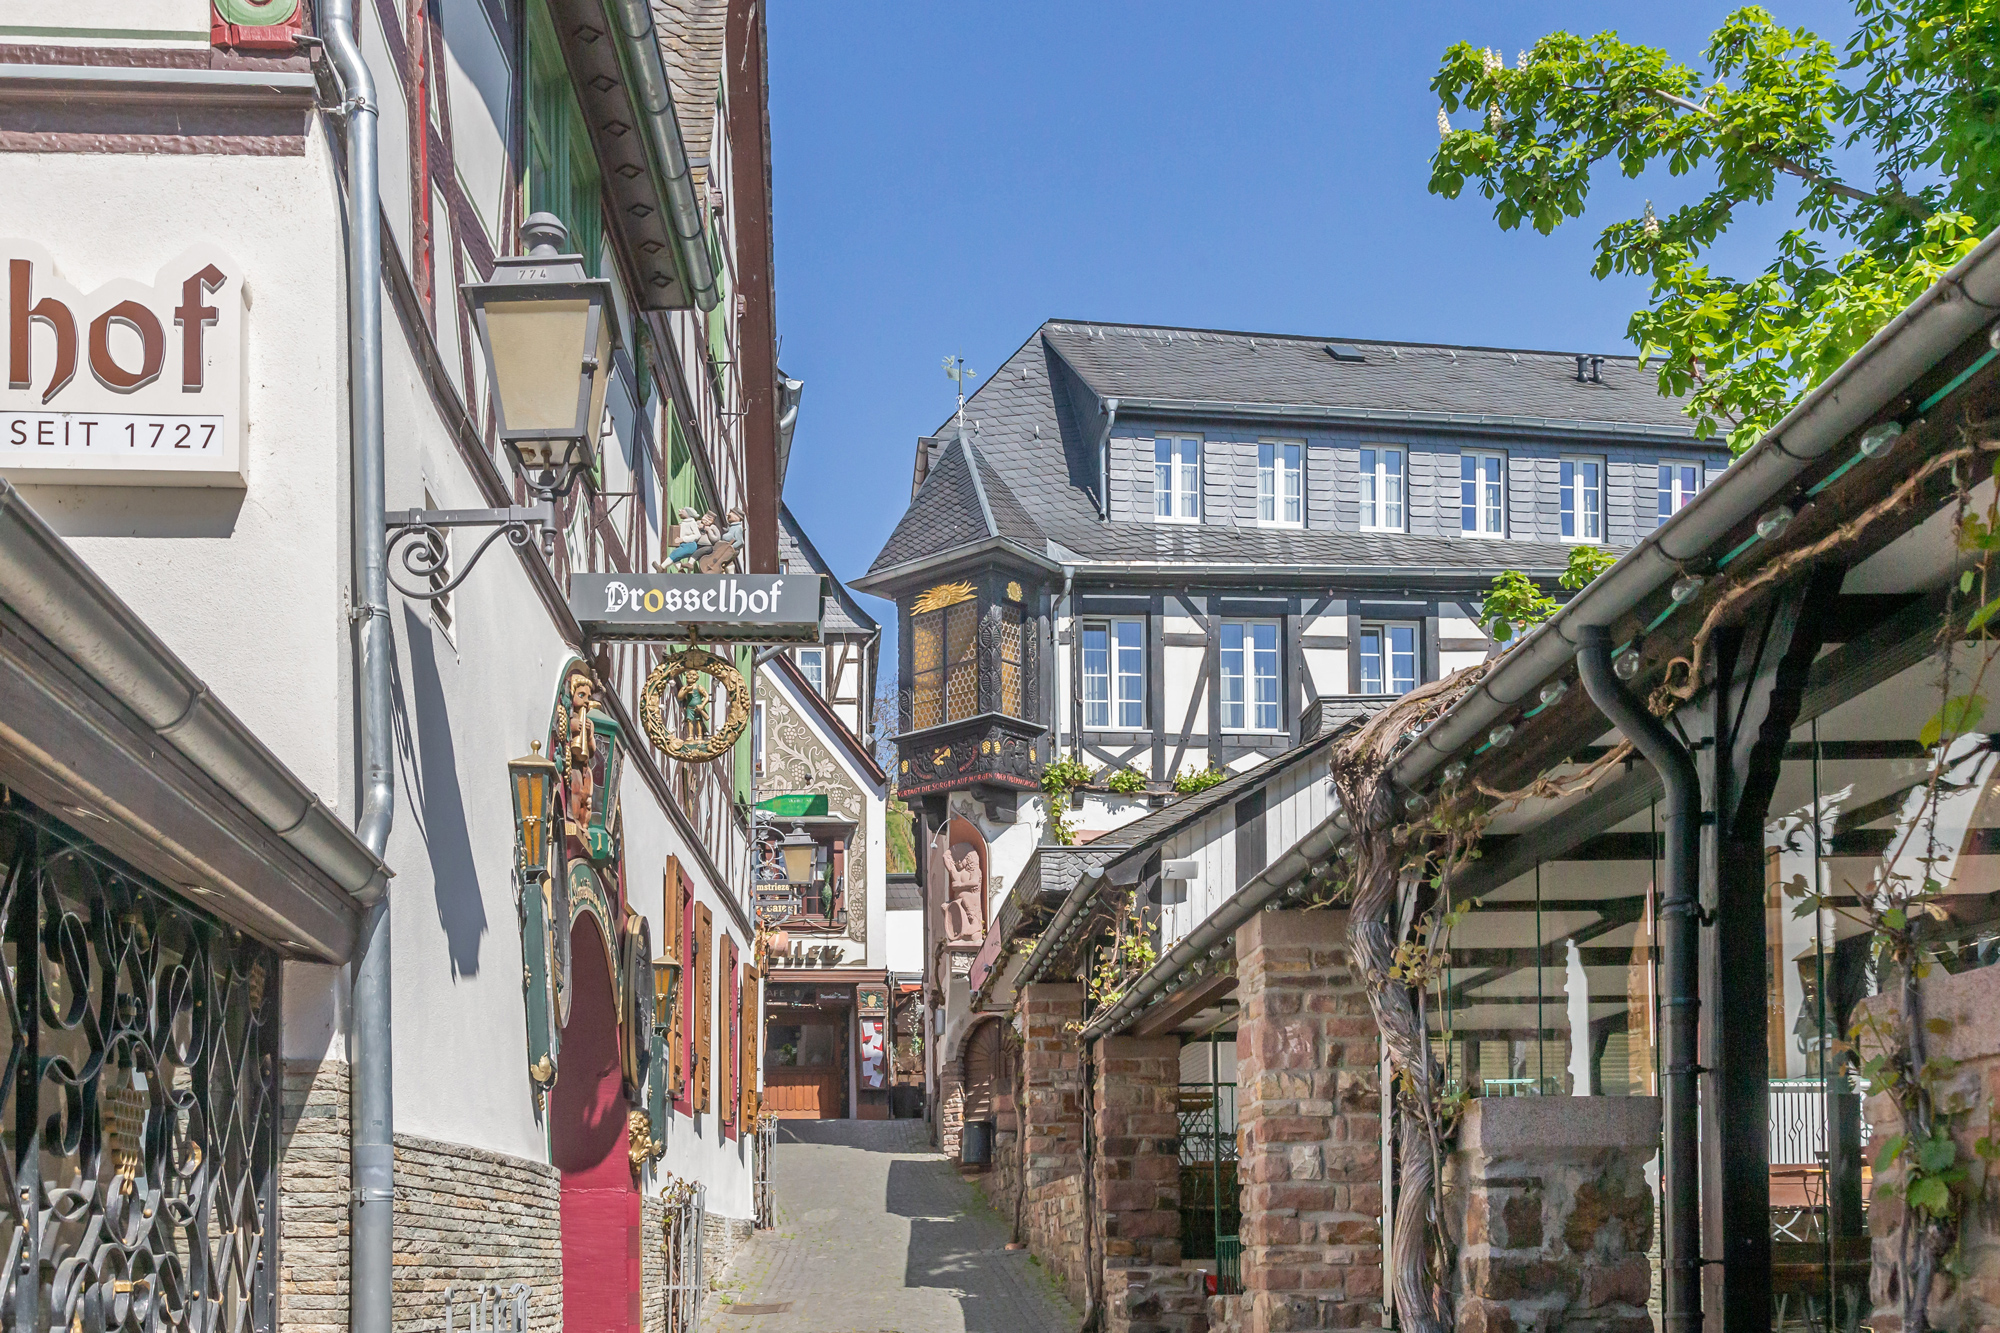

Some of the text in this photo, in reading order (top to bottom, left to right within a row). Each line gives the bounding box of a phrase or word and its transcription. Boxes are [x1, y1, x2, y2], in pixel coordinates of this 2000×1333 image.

[519, 269, 546, 280] 774
[9, 259, 227, 405] hof
[10, 419, 216, 449] SEIT 1727
[604, 579, 784, 617] Drosselhof
[921, 784, 932, 793] DIE
[932, 778, 956, 791] SORGEN
[957, 776, 968, 786] AUF
[968, 772, 993, 783] MORGEN
[756, 882, 790, 891] mstrieze
